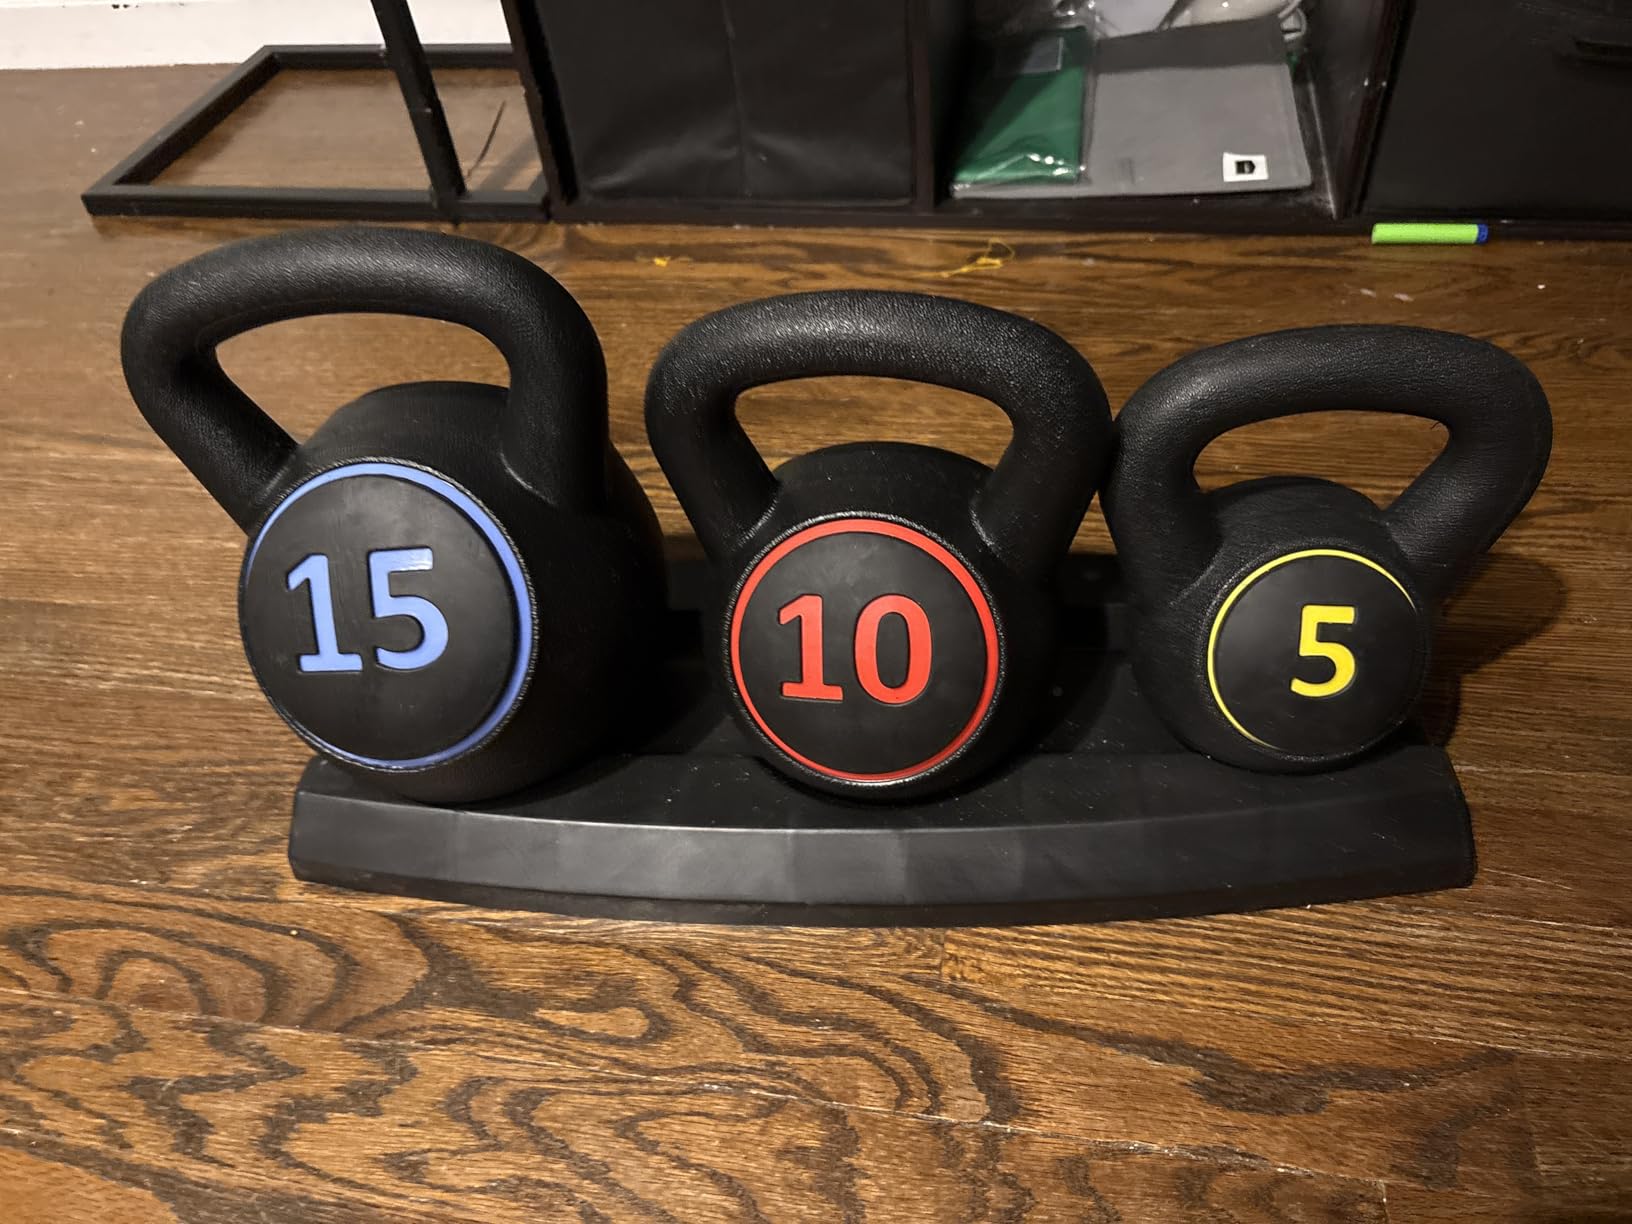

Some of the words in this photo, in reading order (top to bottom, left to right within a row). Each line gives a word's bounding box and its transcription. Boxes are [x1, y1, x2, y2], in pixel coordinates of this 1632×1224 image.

[287, 547, 449, 673] 15
[778, 594, 933, 704] 10
[1290, 604, 1356, 698] 5
